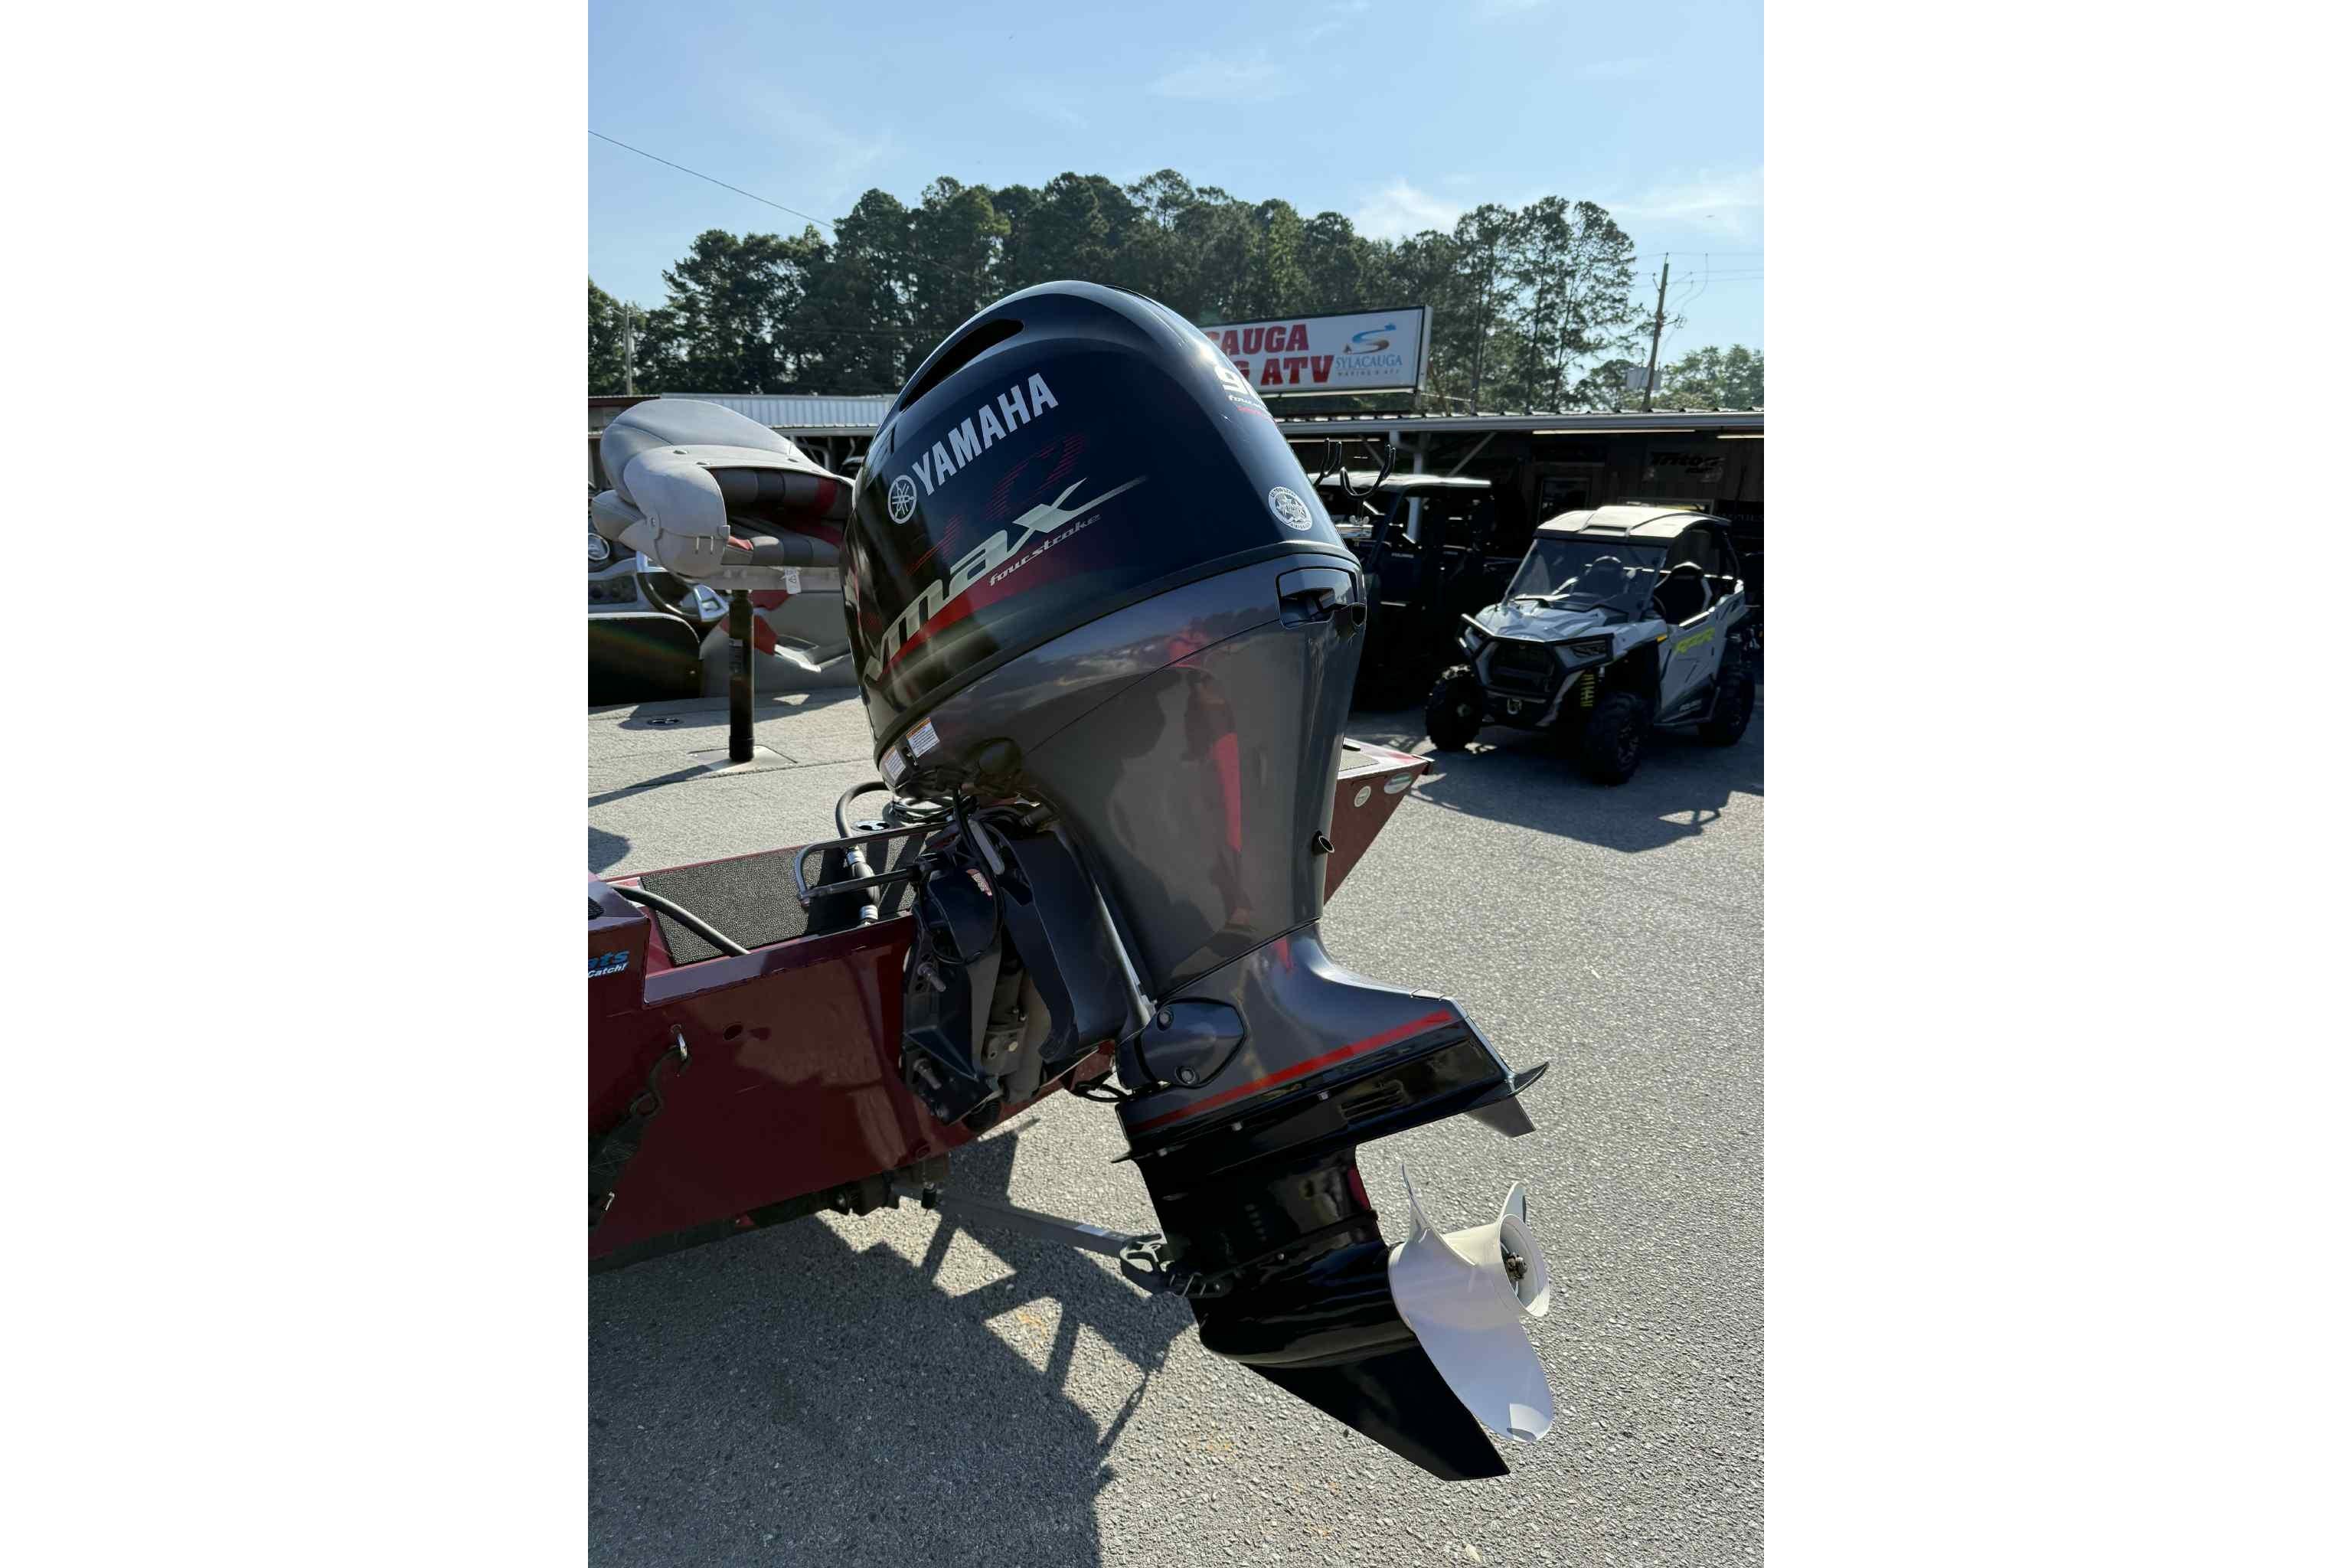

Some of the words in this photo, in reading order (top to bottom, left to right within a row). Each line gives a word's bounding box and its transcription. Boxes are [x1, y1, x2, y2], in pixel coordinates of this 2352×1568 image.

[1260, 354, 1334, 386] ATV
[1335, 354, 1403, 368] SYLACAUGA
[911, 372, 1059, 496] YAMAHA
